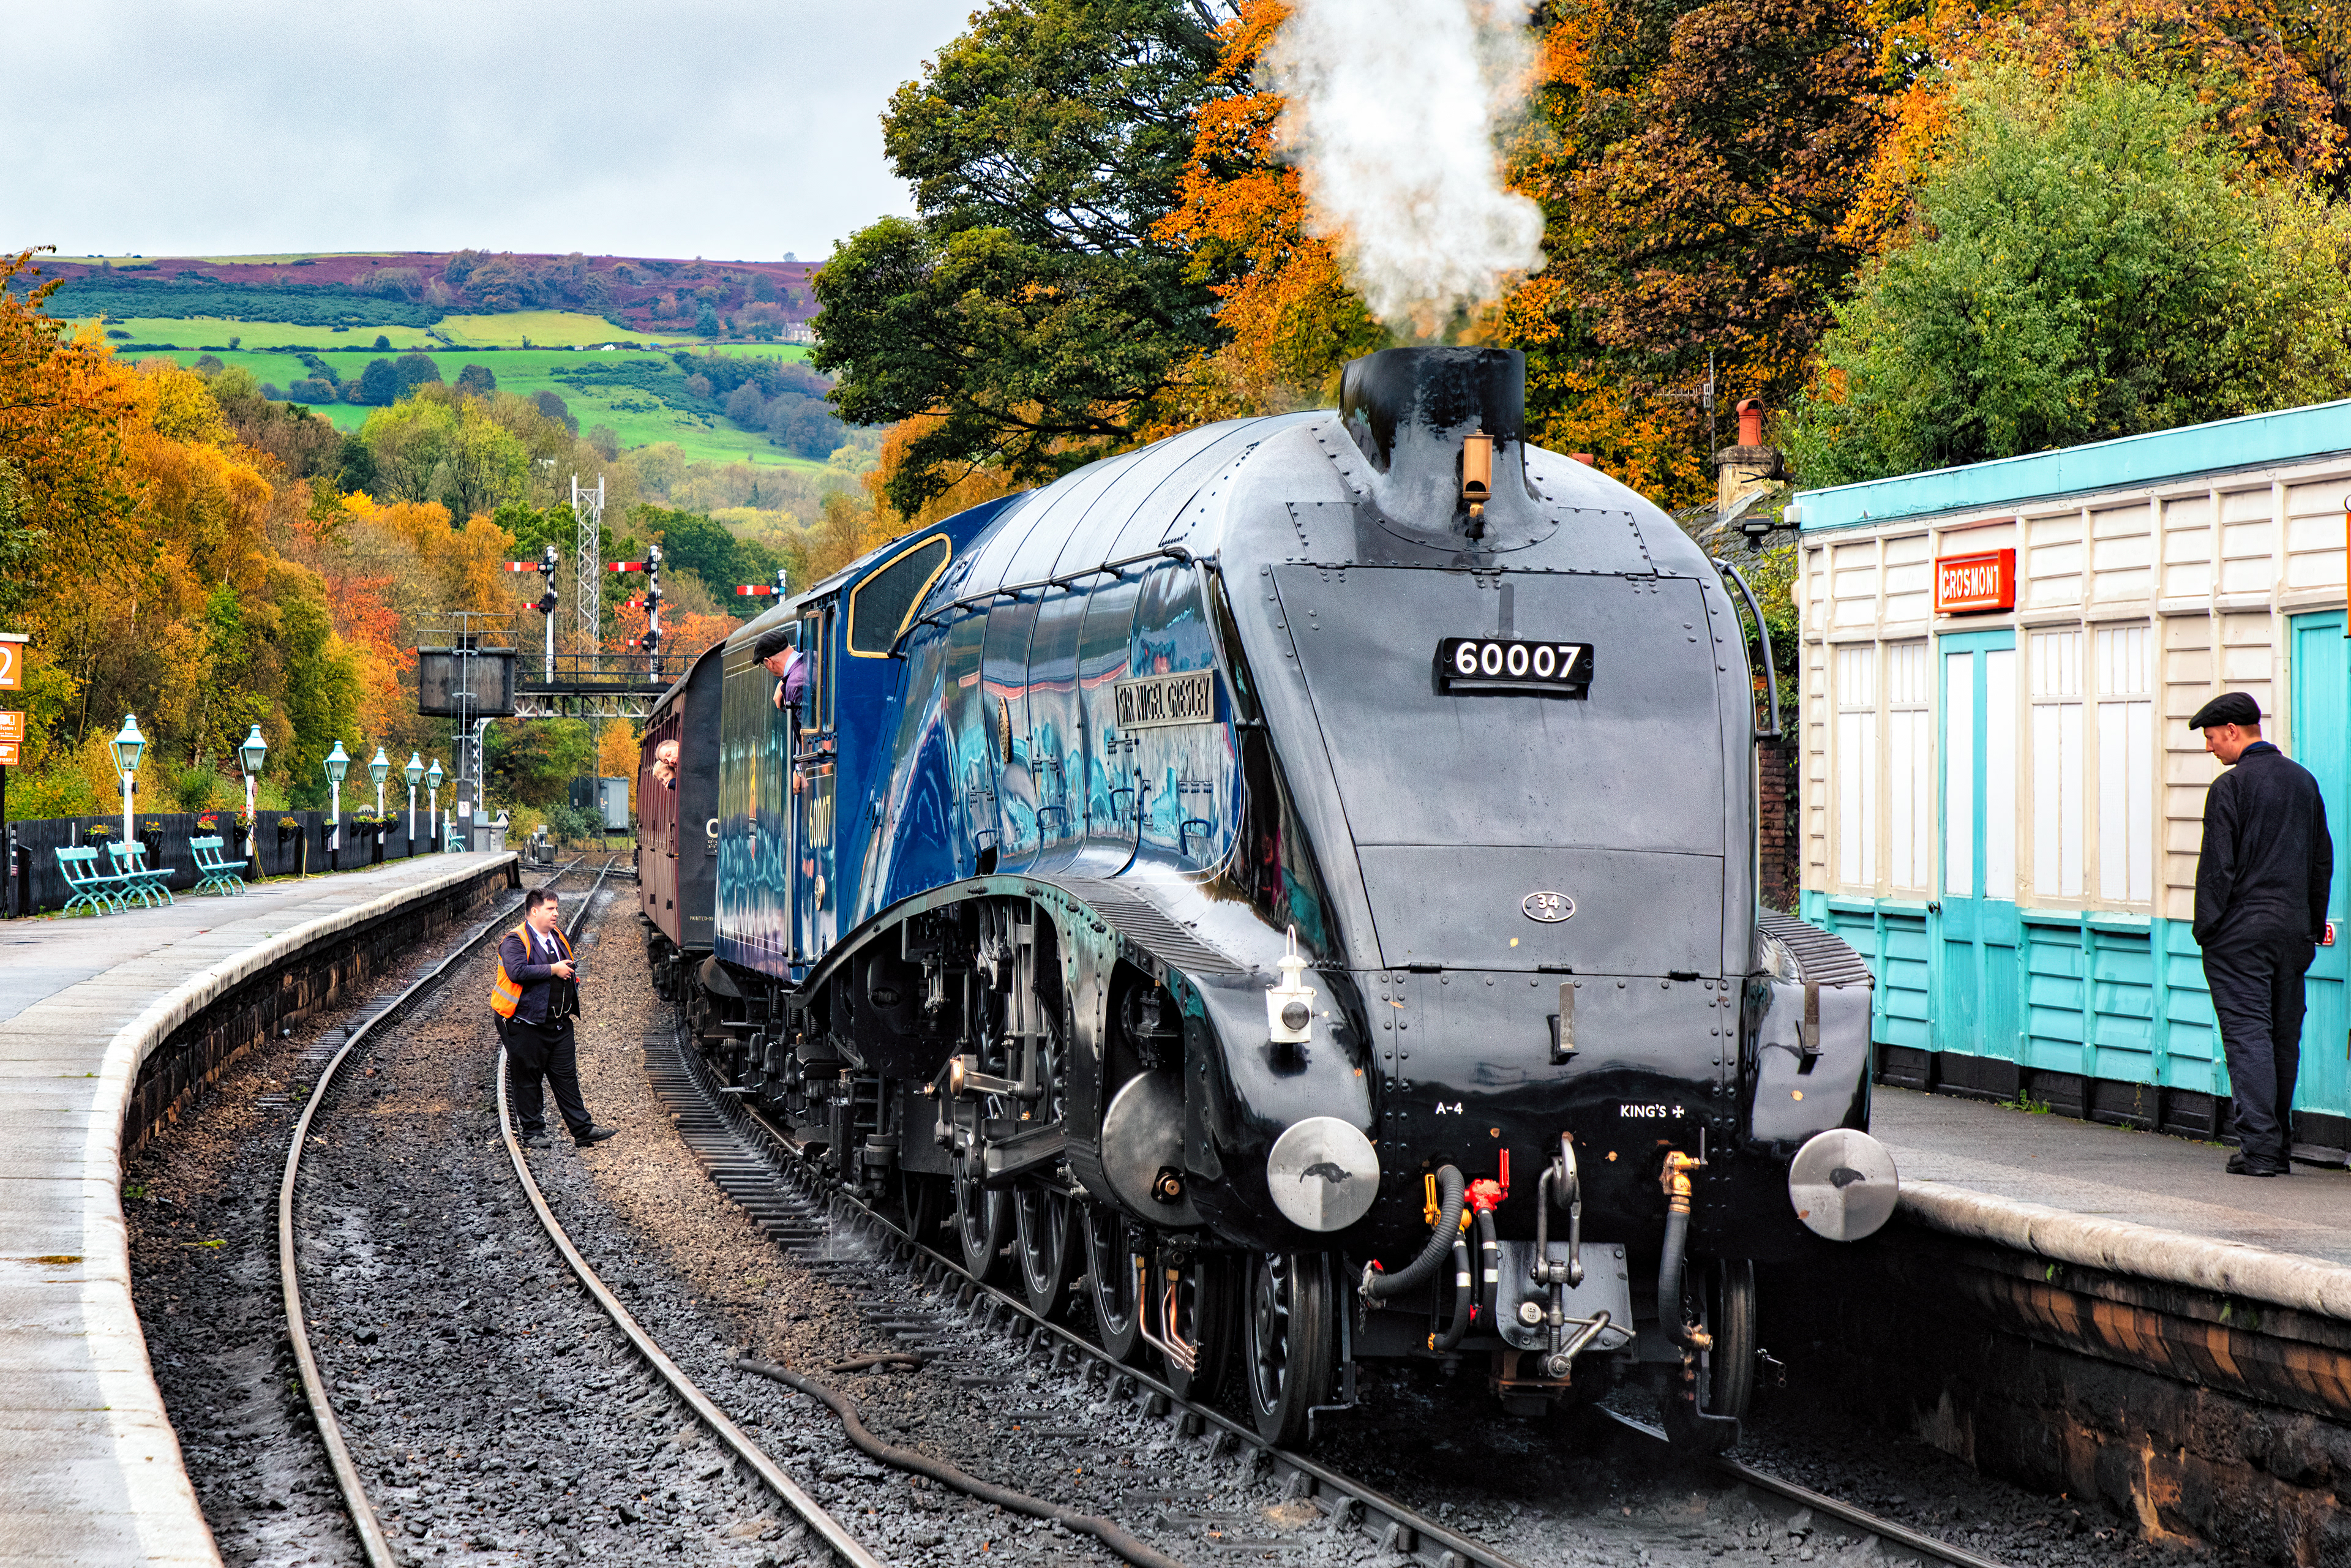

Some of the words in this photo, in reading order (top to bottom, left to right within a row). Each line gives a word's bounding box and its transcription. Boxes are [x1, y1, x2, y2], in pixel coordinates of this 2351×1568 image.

[1943, 565, 1998, 598] GROSMONT
[0, 647, 13, 685] 2
[1457, 642, 1581, 678] 60007
[1119, 686, 1135, 723] SIR
[1136, 683, 1166, 721] NIGEL
[1168, 677, 1210, 718] GRESLEY
[809, 795, 831, 849] 60007
[1537, 894, 1560, 909] 34
[1544, 908, 1556, 919] A
[1435, 1101, 1463, 1114] A-4
[1621, 1103, 1667, 1117] KING'S
